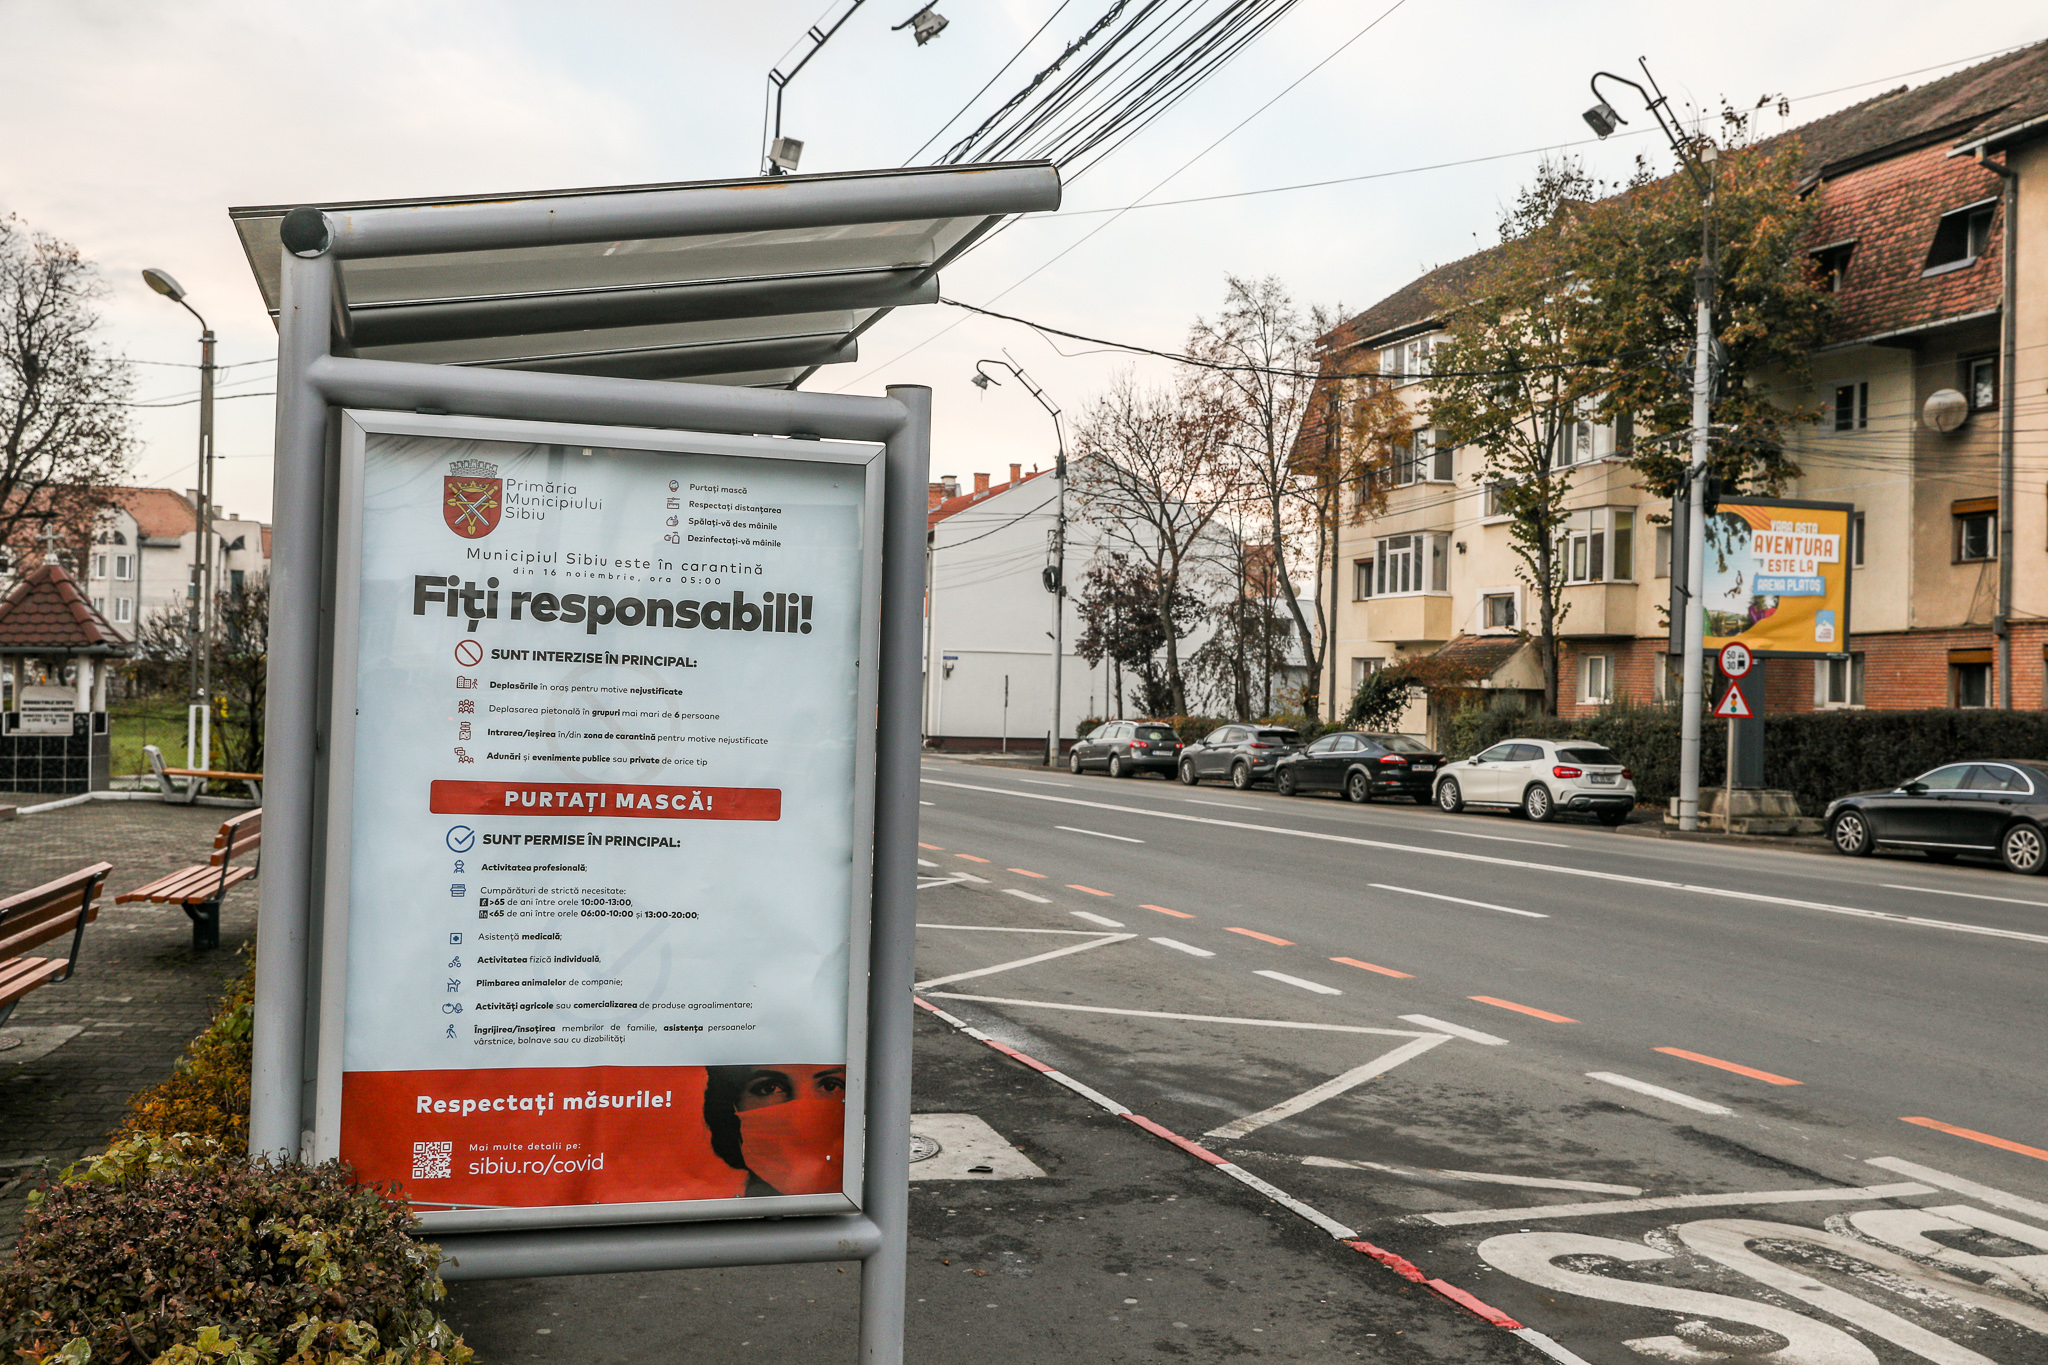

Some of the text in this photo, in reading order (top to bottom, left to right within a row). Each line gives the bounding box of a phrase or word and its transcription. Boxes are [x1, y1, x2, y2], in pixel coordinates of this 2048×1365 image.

[507, 479, 576, 496] Primăria
[690, 484, 722, 493] Purtați
[506, 493, 601, 513] Municipiului
[689, 501, 781, 514] Respectați distanțarea
[506, 505, 544, 520] Sibiu
[689, 518, 730, 527] Spălați-vă
[750, 522, 777, 530] mâinile
[1795, 522, 1818, 534] ASTA
[688, 535, 781, 547] Dezinfectați-vă mâinile
[1754, 535, 1833, 557] AVENTURA
[467, 548, 762, 575] Municipiul Sibiu este în carantină
[1768, 559, 1813, 572] ESTE LA
[567, 571, 640, 581] noiembrie,
[1757, 579, 1786, 591] ARENA
[413, 575, 813, 635] Fiți responsabili!
[491, 649, 697, 667] SUNT INTERZISE ÎN PRINCIPAL:
[1727, 651, 1736, 659] 50
[1727, 661, 1735, 669] 30
[490, 681, 538, 690] Deplasările
[630, 687, 683, 695] nejustificate
[489, 705, 538, 713] Deplasarea
[541, 707, 580, 715] pietonală
[592, 709, 620, 717] grupuri
[488, 729, 556, 739] Intrarea/ieșirea
[719, 736, 768, 745] nejustificate
[487, 752, 520, 760] Adunări
[523, 754, 529, 762] și
[582, 755, 610, 763] publice
[630, 756, 659, 764] private
[505, 791, 712, 812] PURTAȚI MASCĂ!
[483, 832, 680, 847] SUNT PERMISE ÎN PRINCIPAL:
[533, 864, 587, 872] profesională;
[481, 887, 535, 895] Cumpărături
[581, 899, 632, 907] 10:00-13:00,
[636, 911, 642, 919] și
[645, 911, 699, 919] 13:00-20:00;
[478, 933, 519, 941] Asistență
[582, 978, 622, 986] companie;
[475, 1002, 518, 1011] Activități
[520, 1002, 553, 1011] agricole
[652, 1002, 685, 1010] produse
[688, 1002, 752, 1010] agroalimentare;
[474, 1025, 555, 1035] Îngrijirea/însoțirea
[627, 1024, 657, 1032] familie,
[664, 1024, 703, 1033] asistența
[708, 1023, 756, 1032] persoanelor
[584, 1035, 625, 1044] dizabilități
[417, 1090, 671, 1116] Respectați măsurile!
[469, 1153, 603, 1175] sibiu.ro/covid
